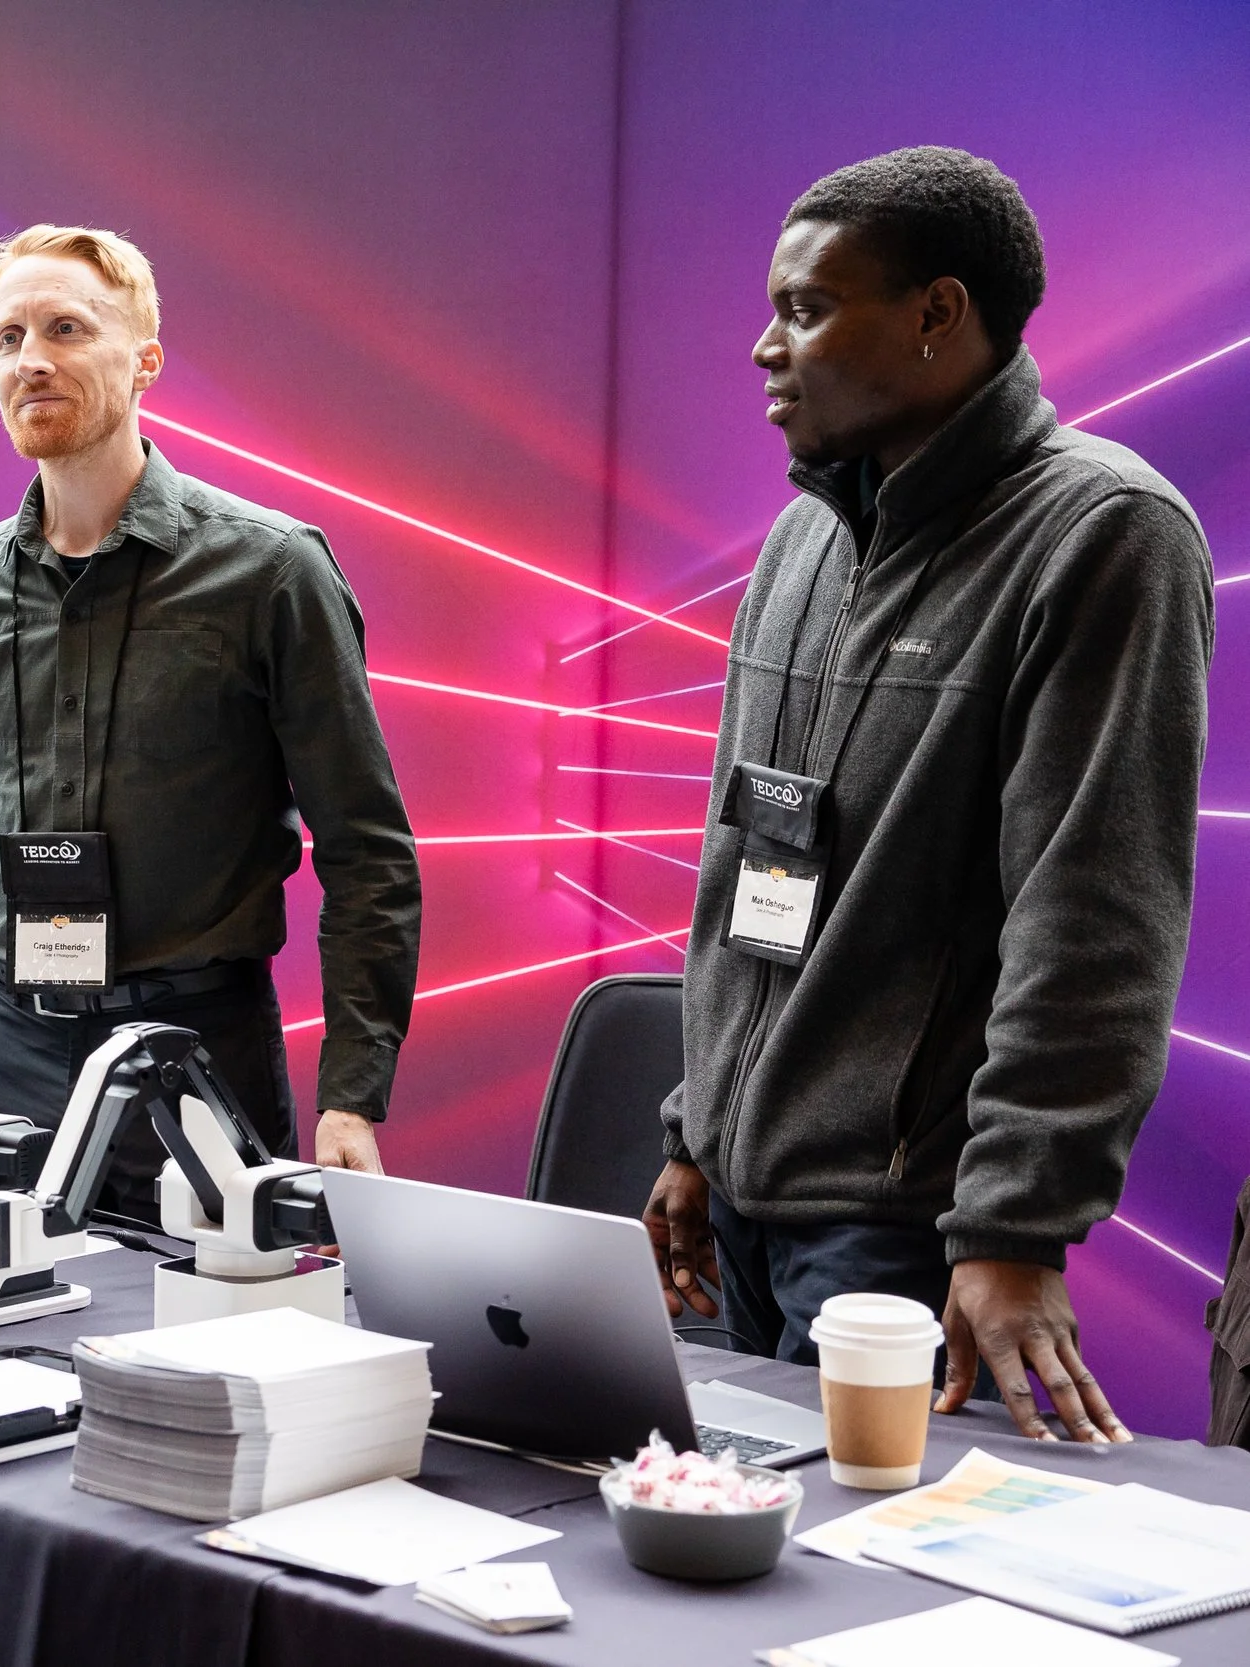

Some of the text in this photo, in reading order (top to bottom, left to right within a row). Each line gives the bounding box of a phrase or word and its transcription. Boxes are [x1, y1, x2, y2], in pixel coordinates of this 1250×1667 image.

[896, 641, 932, 655] Columbia
[751, 777, 793, 804] TEDCO
[19, 845, 72, 859] TEDCO
[750, 895, 764, 906] Mak
[33, 942, 53, 952] Craig
